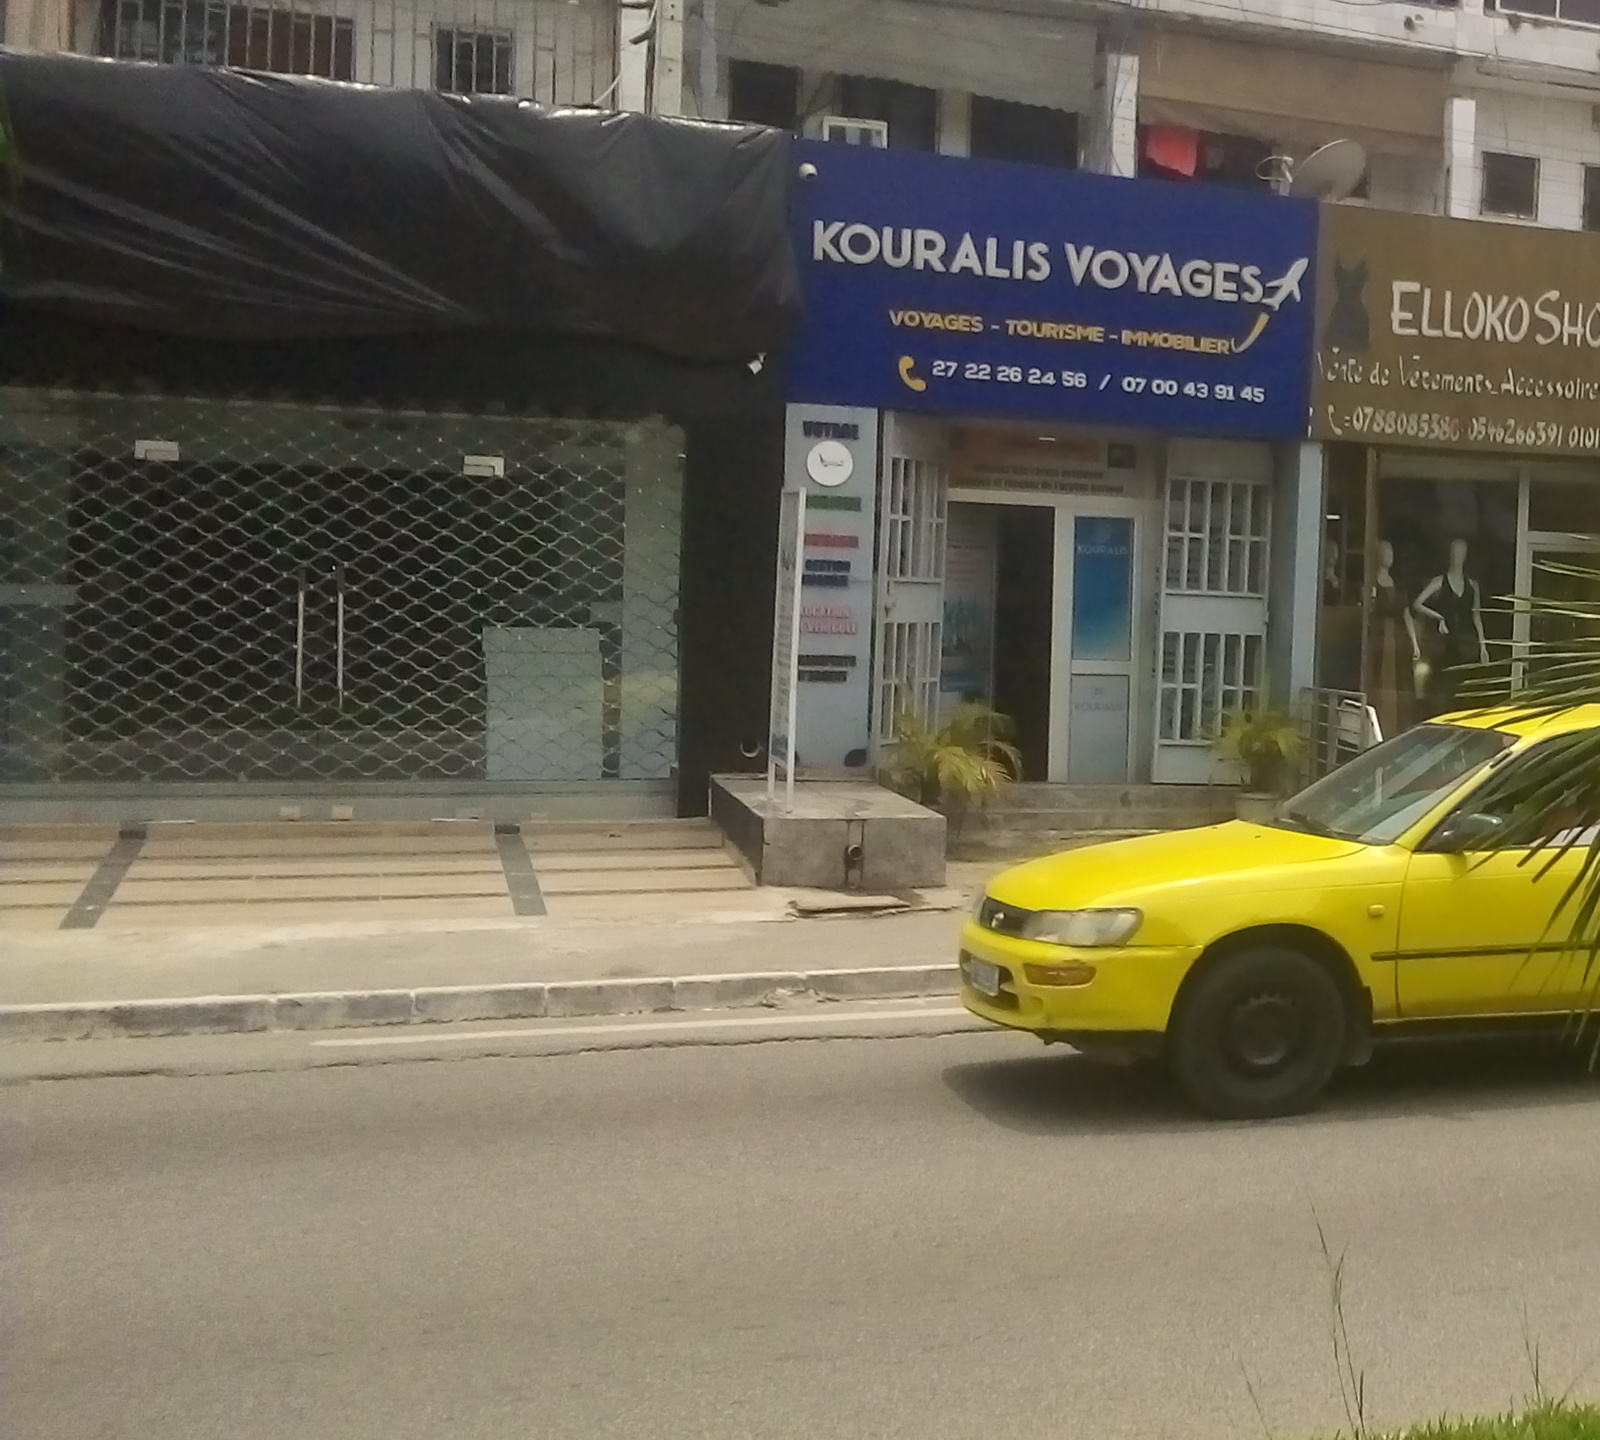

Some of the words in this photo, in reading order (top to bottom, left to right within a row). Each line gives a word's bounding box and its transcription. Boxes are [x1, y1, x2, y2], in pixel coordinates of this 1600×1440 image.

[813, 219, 1051, 282] KOURALIS
[1064, 242, 1265, 304] VOYAGES
[890, 309, 984, 333] VOYAGES
[1005, 319, 1104, 343] TOURISME
[1121, 329, 1230, 354] IMMOBILIER
[932, 360, 959, 378] 27
[965, 362, 992, 381] 22
[996, 365, 1023, 384] 26
[1028, 367, 1056, 387] 24
[1062, 370, 1087, 389] 56
[1098, 373, 1112, 391] /
[1121, 377, 1147, 395] 07
[1152, 378, 1178, 397] 00
[1183, 380, 1209, 399] 43
[1214, 382, 1235, 401] 91
[1240, 384, 1265, 403] 45
[1369, 362, 1390, 387] de
